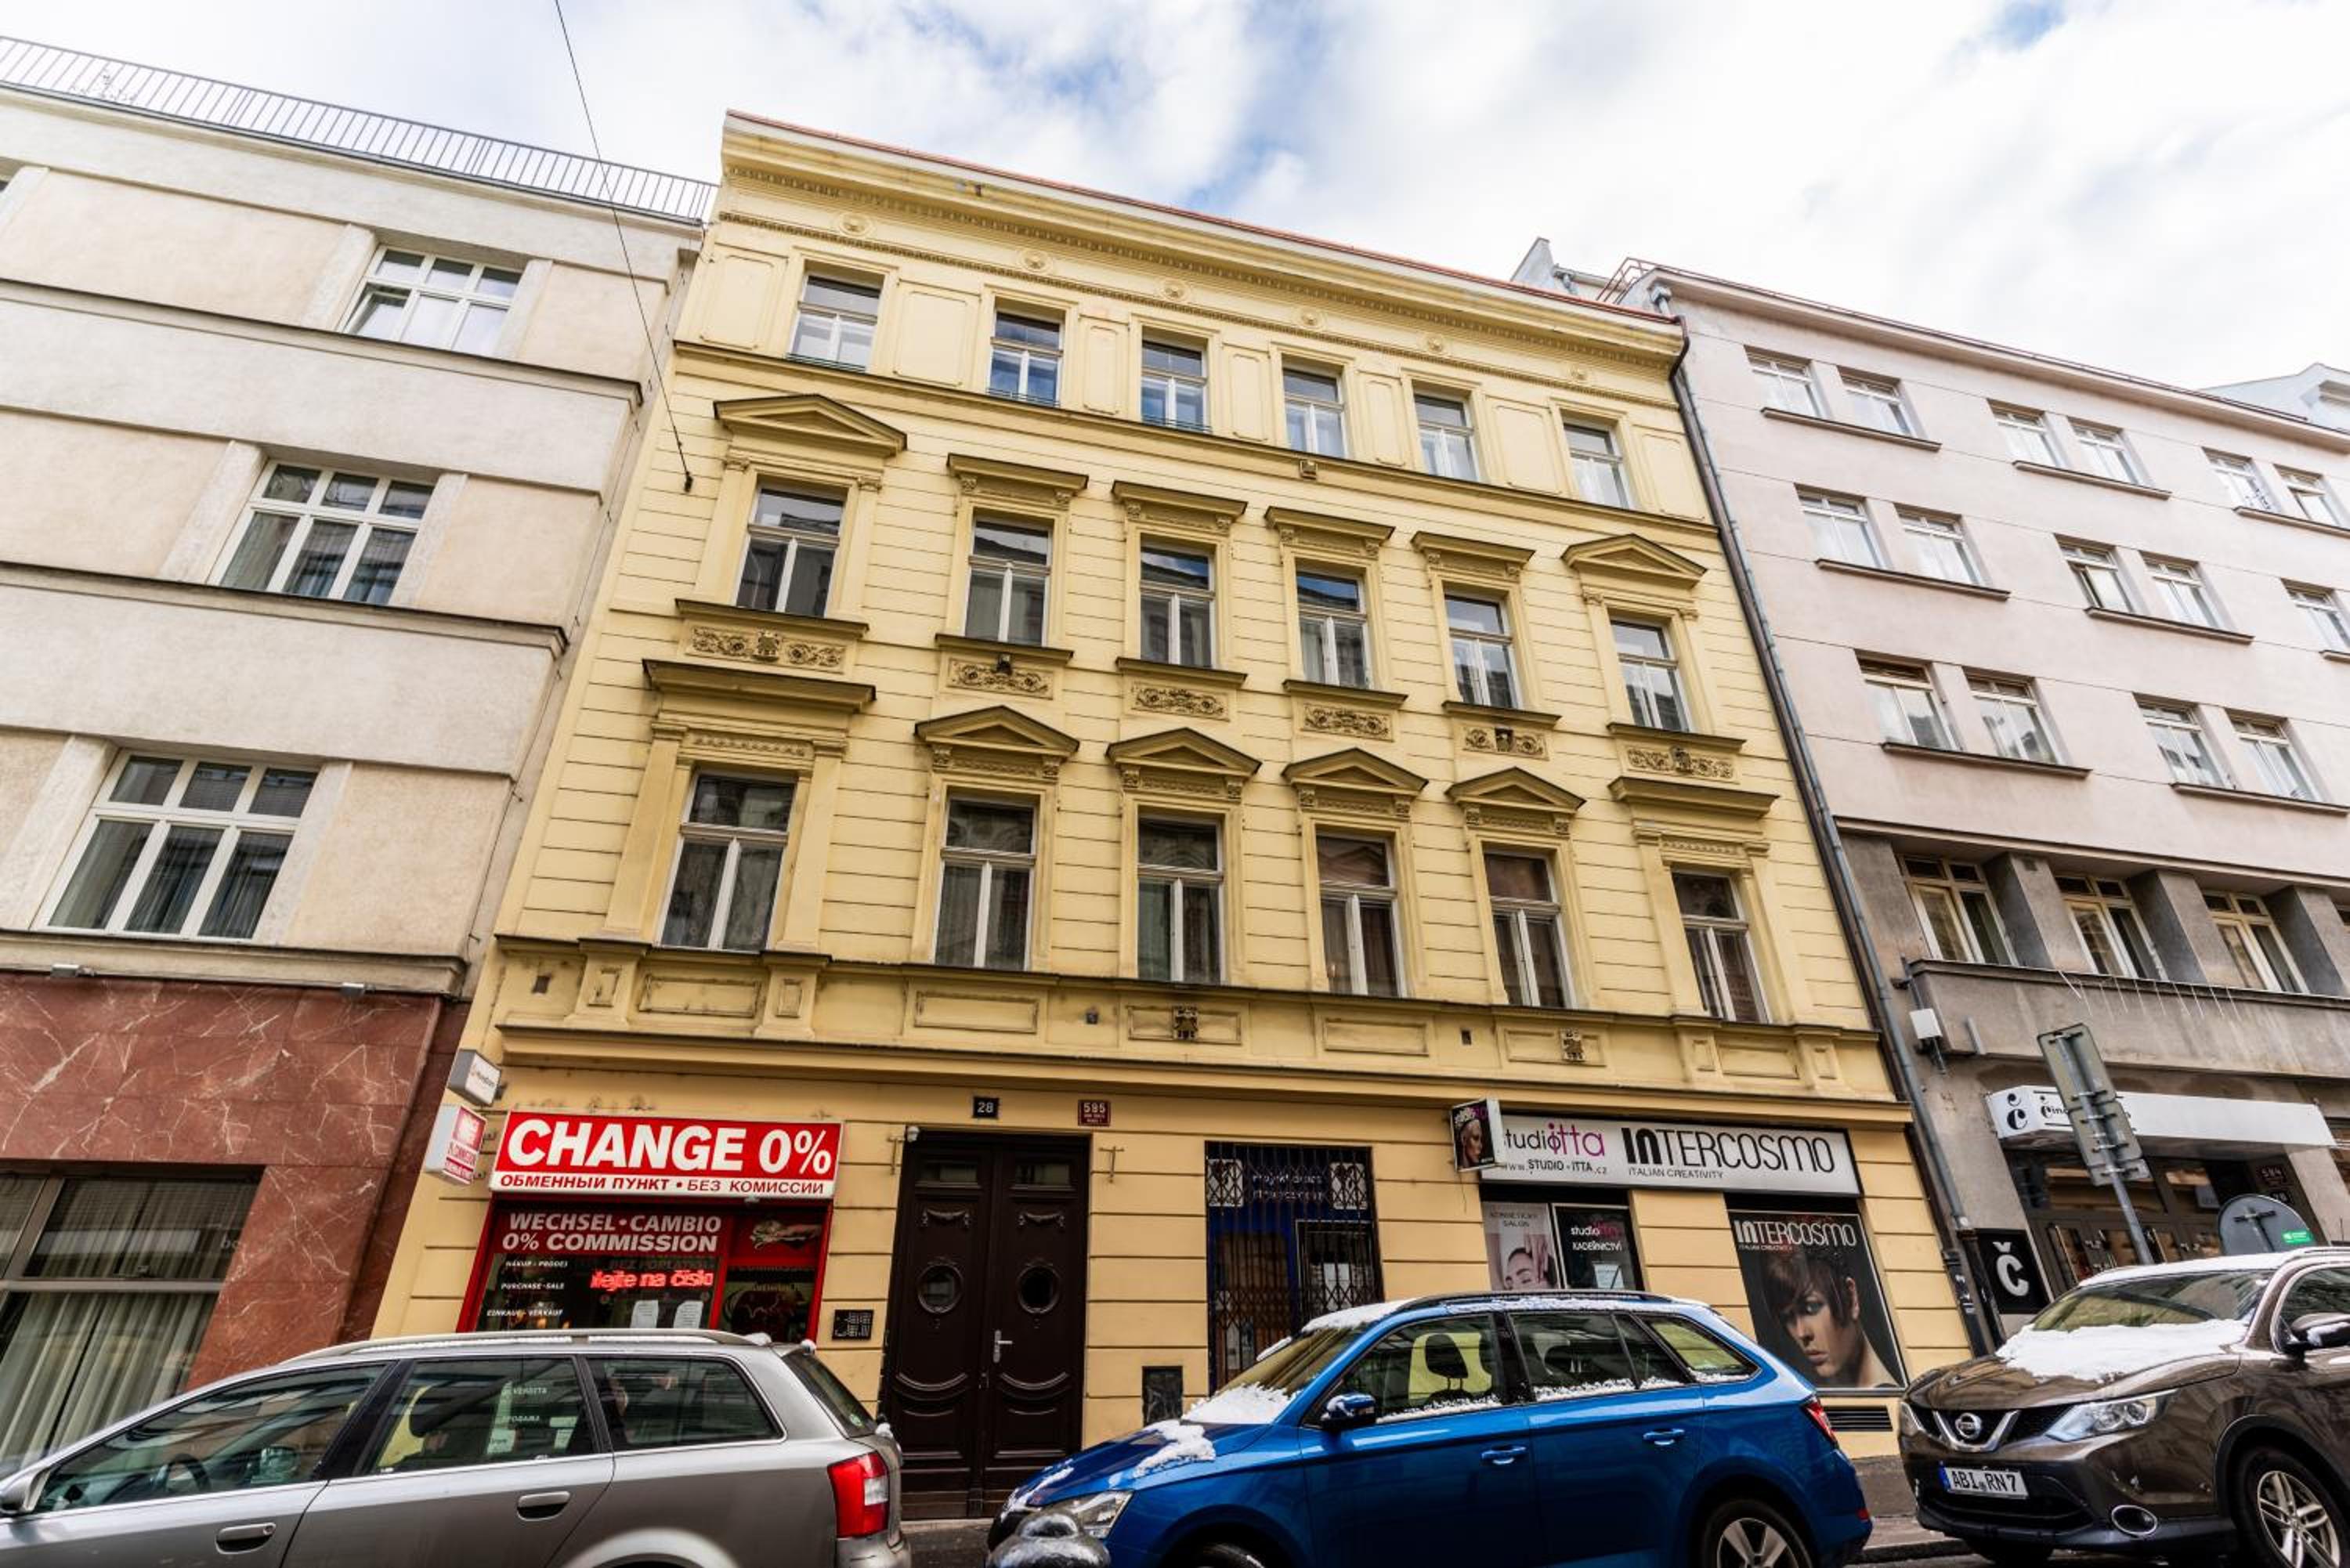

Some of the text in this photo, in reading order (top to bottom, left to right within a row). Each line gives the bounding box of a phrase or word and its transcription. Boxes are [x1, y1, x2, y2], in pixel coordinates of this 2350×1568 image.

[977, 1101, 994, 1113] 28
[508, 1119, 747, 1171] CHANGE
[757, 1129, 832, 1175] 0%
[1504, 1129, 1561, 1151] tudio
[1621, 1127, 1835, 1173] INTERCOSMO
[1629, 1167, 1723, 1179] ITALIAN CREATIVITY
[612, 1177, 671, 1190] ПУНКТ
[686, 1179, 721, 1192] БЕЗ
[729, 1180, 824, 1194] КОМИССИИ
[509, 1213, 722, 1234] WECHSEL CAMBIO
[1571, 1225, 1600, 1237] studio
[1733, 1219, 1856, 1247] INTERCOSMO
[501, 1232, 718, 1252] 0% COMMISSION
[1992, 1241, 2030, 1297] Č
[639, 1273, 667, 1288] na
